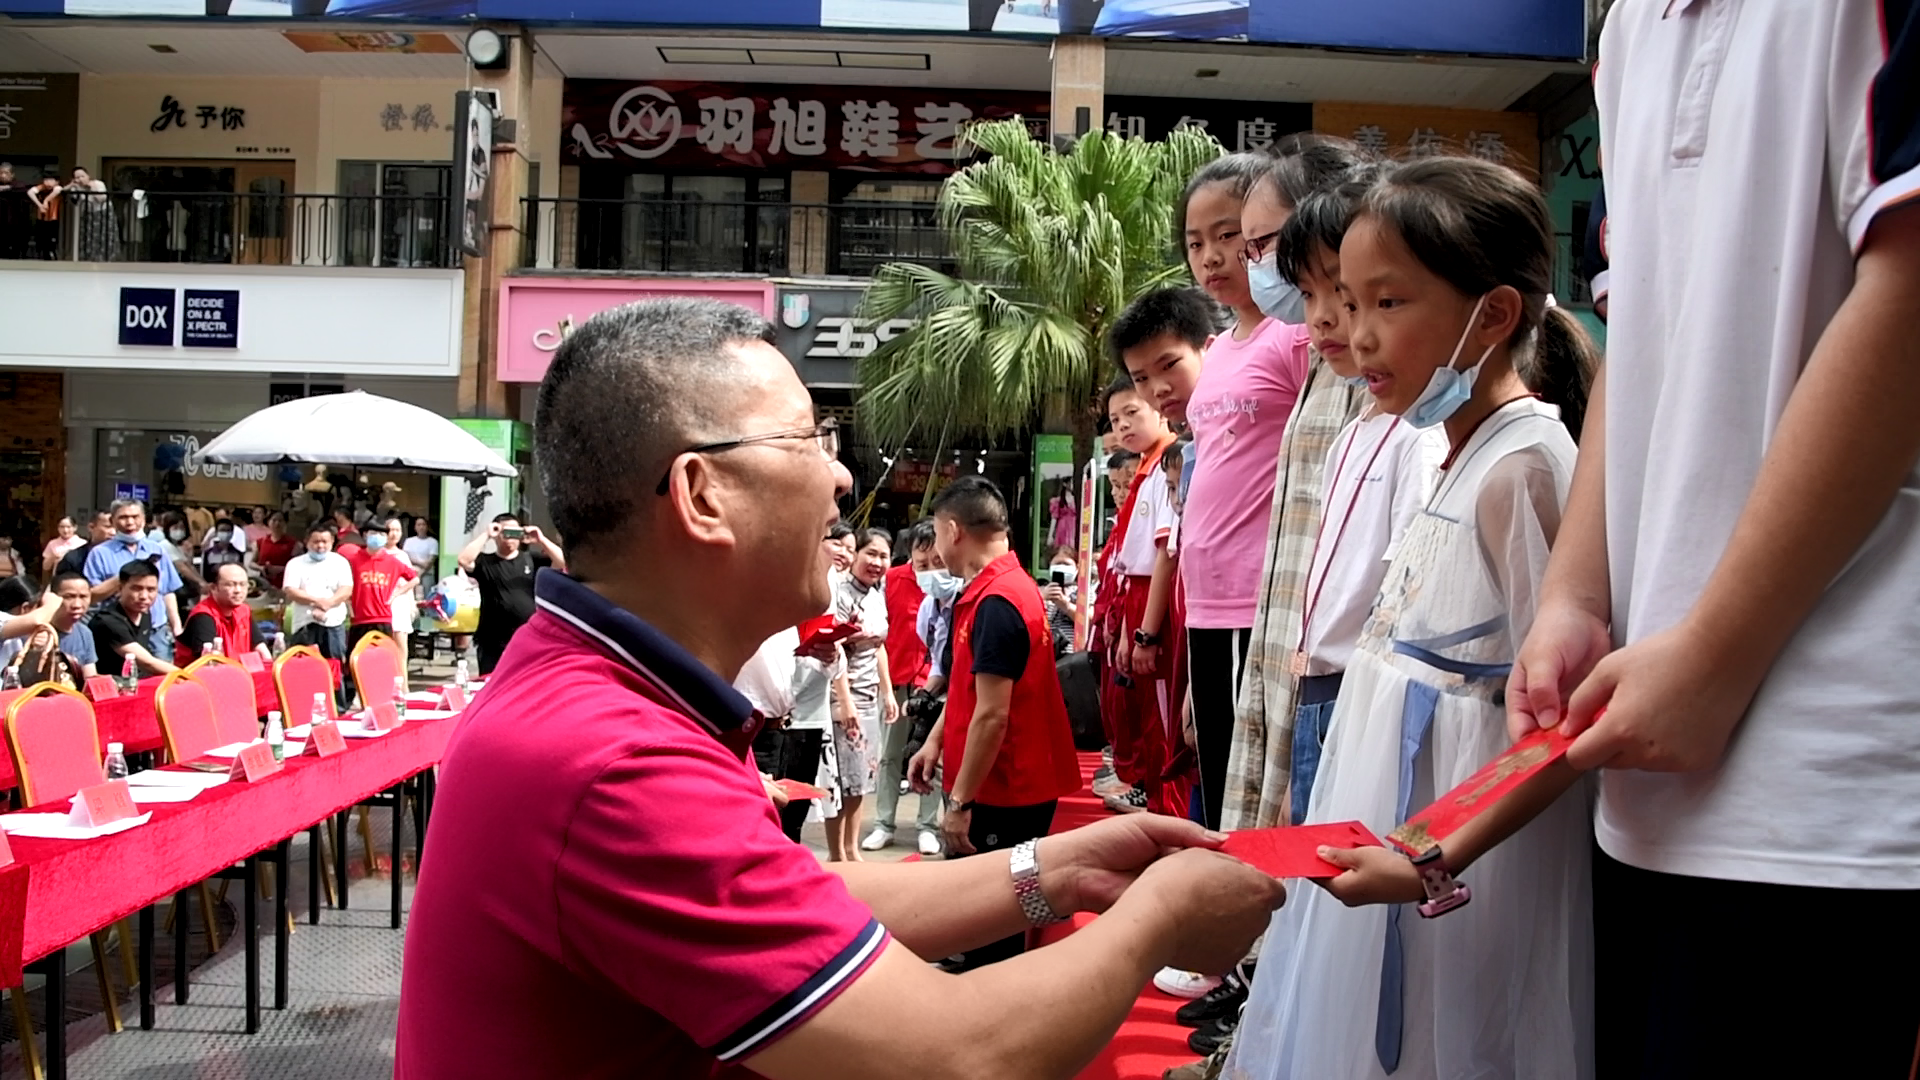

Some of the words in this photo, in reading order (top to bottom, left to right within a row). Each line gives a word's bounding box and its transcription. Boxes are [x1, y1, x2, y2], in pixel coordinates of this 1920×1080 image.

[696, 96, 973, 159] 羽旭鞋艺
[187, 298, 224, 308] DECIDE
[126, 304, 168, 329] DOX
[187, 309, 202, 320] ON
